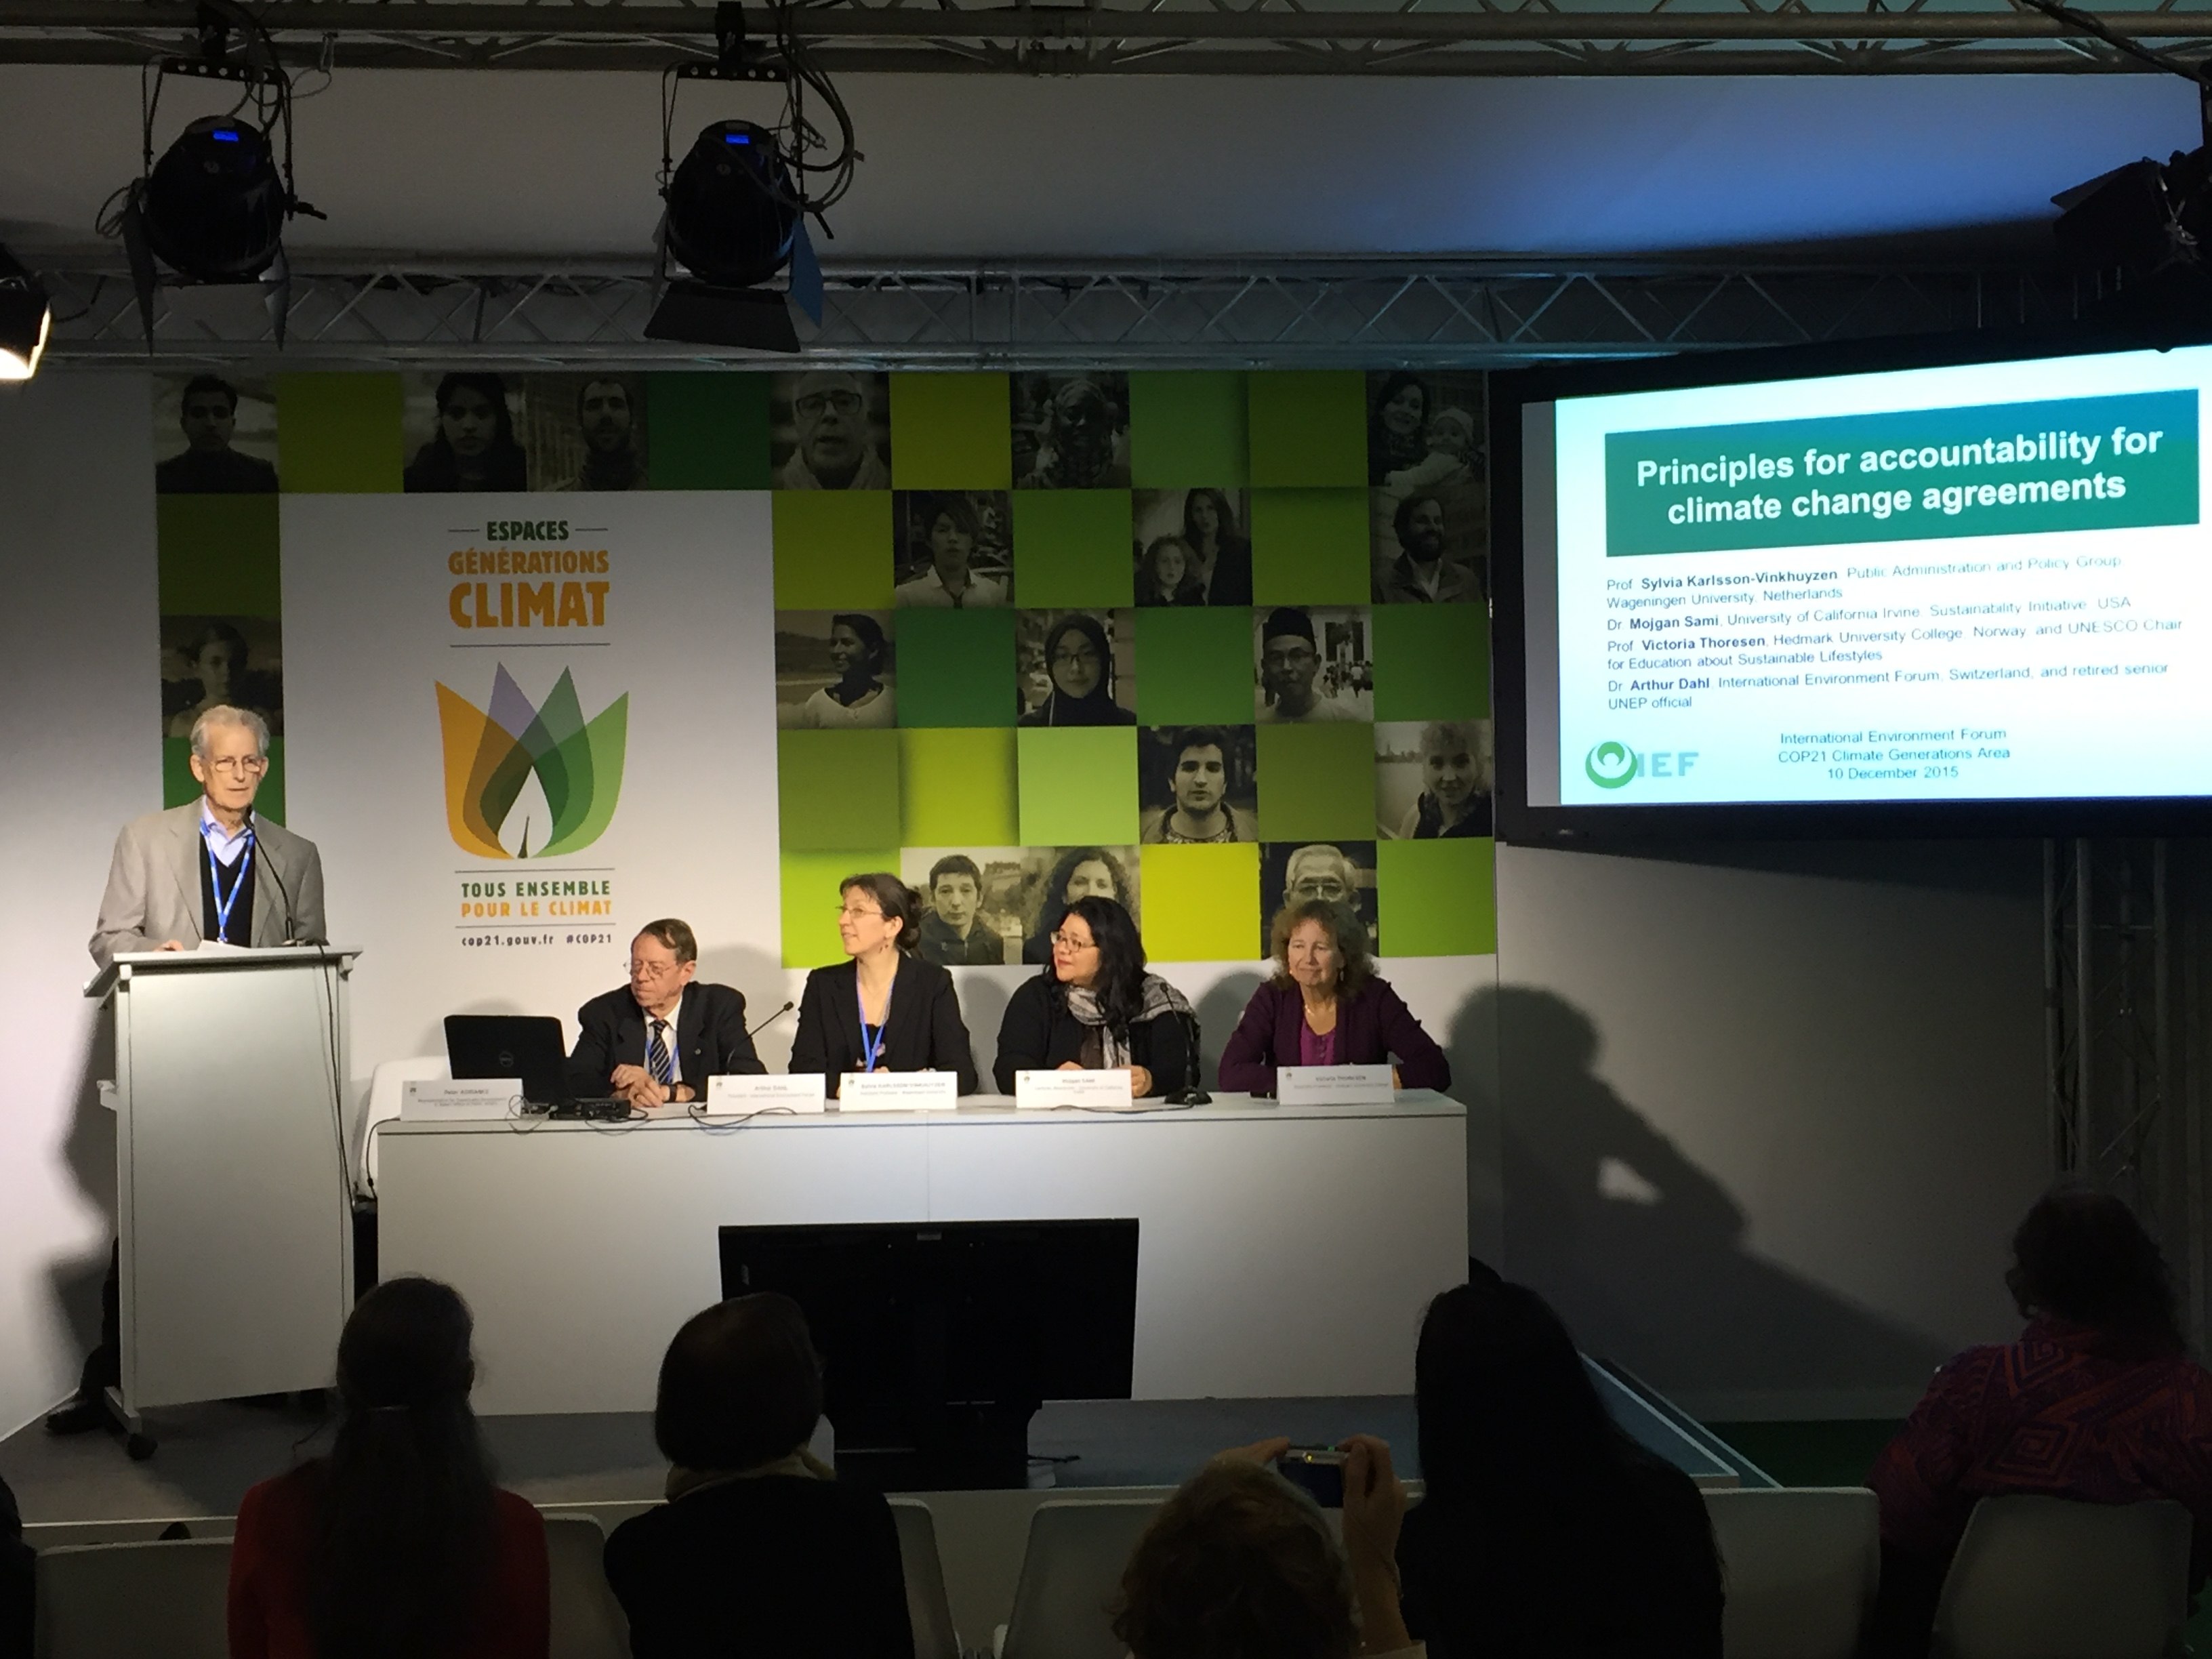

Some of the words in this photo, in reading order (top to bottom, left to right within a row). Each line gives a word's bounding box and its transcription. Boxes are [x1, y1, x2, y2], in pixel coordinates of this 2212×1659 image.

[1637, 453, 1794, 487] Principles
[1803, 449, 1851, 476] for
[1860, 431, 2101, 472] accountability
[2111, 426, 2163, 455] for
[1668, 494, 1781, 524] climate
[1791, 489, 1912, 519] change
[1922, 472, 2126, 514] agreements
[487, 520, 569, 541] ESPACES
[447, 547, 609, 575] GÉNÉRATIONS
[1641, 577, 1682, 592] Sylvia
[1847, 567, 1885, 578] Public
[1891, 561, 1990, 576] Administration
[1996, 560, 2022, 572] and
[2027, 558, 2069, 570] Policy
[449, 581, 610, 629] CLIMAT
[1606, 597, 1685, 611] Wageningen
[1763, 588, 1843, 600] Netherlands
[1630, 618, 1679, 632] Mojgan
[1727, 613, 1791, 626] University
[1797, 611, 1809, 622] of
[1813, 609, 1877, 621] California
[1929, 602, 2021, 616] Sustainability
[2097, 596, 2131, 609] USA
[1641, 638, 1695, 651] Victoria
[1774, 633, 1833, 645] Hedmark
[1839, 630, 1906, 643] University
[2035, 624, 2062, 635] and
[2068, 620, 2137, 634] UNESCO
[2143, 619, 2182, 630] Chair
[1607, 659, 1624, 670] for
[1629, 657, 1692, 669] Education
[1697, 655, 1732, 667] about
[1738, 652, 1815, 665] Sustainable
[1820, 650, 1883, 663] Lifestyles
[1630, 680, 1674, 691] Arthur
[1718, 675, 1799, 688] International
[1805, 672, 1889, 685] Environment
[2040, 665, 2067, 677] and
[2072, 665, 2118, 676] retired
[2124, 665, 2168, 675] senior
[1608, 697, 1647, 710] UNEP
[1651, 696, 1692, 708] official
[1780, 731, 1862, 744] International
[1868, 730, 1954, 743] Environment
[1961, 728, 2006, 741] Forum
[1636, 752, 1700, 777] IEF
[1778, 750, 1826, 762] COP21
[1832, 750, 1883, 762] Climate
[1888, 749, 1972, 761] Generations
[1976, 747, 2010, 759] Area
[1828, 768, 1843, 780] 10
[1848, 767, 1917, 780] December
[1923, 766, 1959, 778] 2015
[461, 882, 506, 897] TOUS
[515, 880, 609, 897] ENSEMBLE
[461, 902, 510, 918] POUR
[520, 901, 539, 916] LE
[548, 900, 611, 916] CLIMAT
[461, 935, 553, 947] cop21.gouv.fr
[566, 934, 611, 943] #COP21
